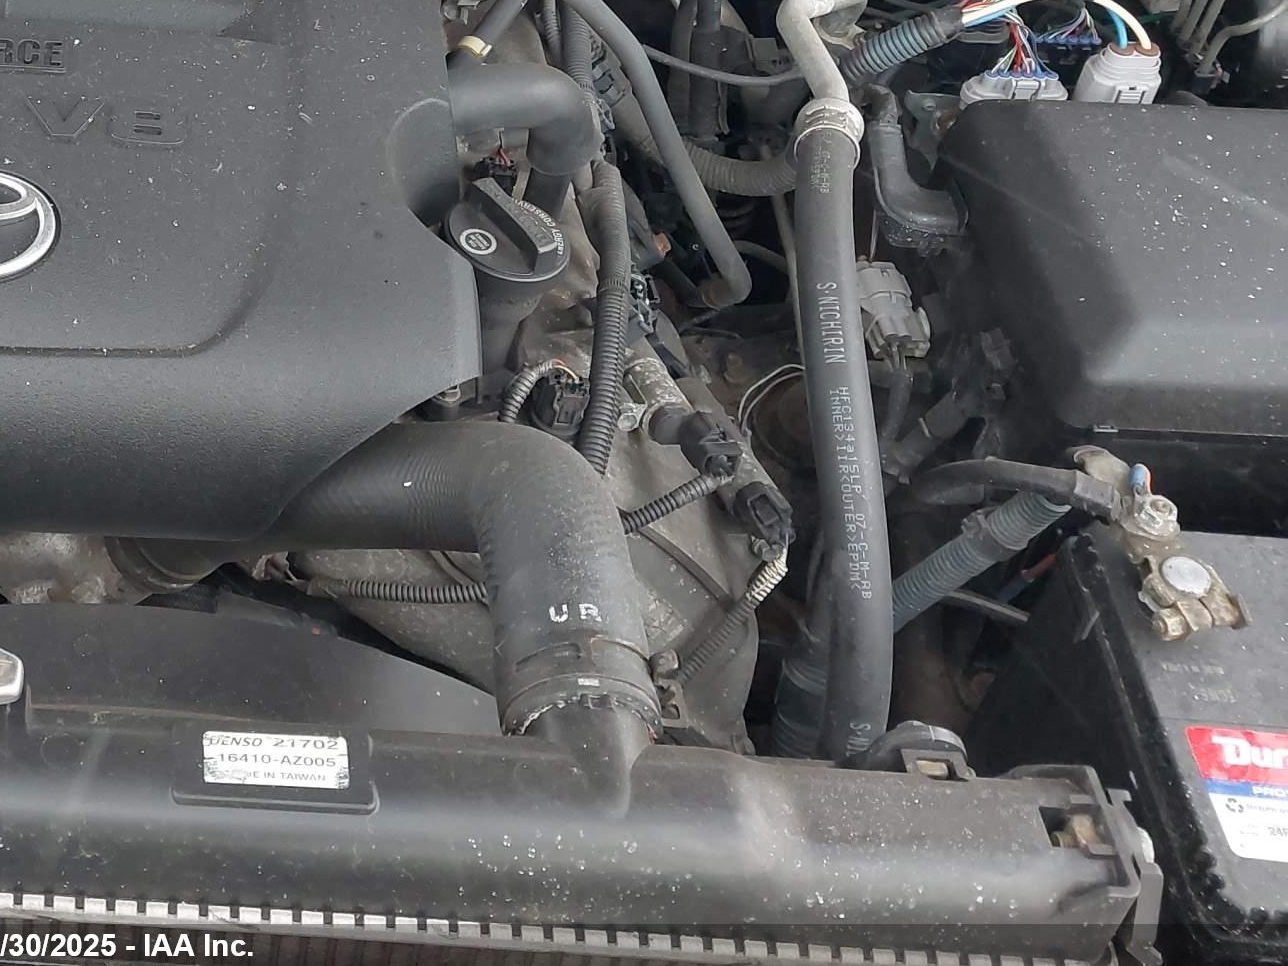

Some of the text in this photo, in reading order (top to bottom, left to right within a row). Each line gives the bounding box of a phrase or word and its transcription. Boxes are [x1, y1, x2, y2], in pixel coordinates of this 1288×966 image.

[24, 96, 186, 146] V8
[208, 735, 339, 750] DENSO 21702
[218, 753, 337, 768] 16410-AZ005
[264, 771, 276, 779] IN
[280, 772, 327, 782] TAIWAN
